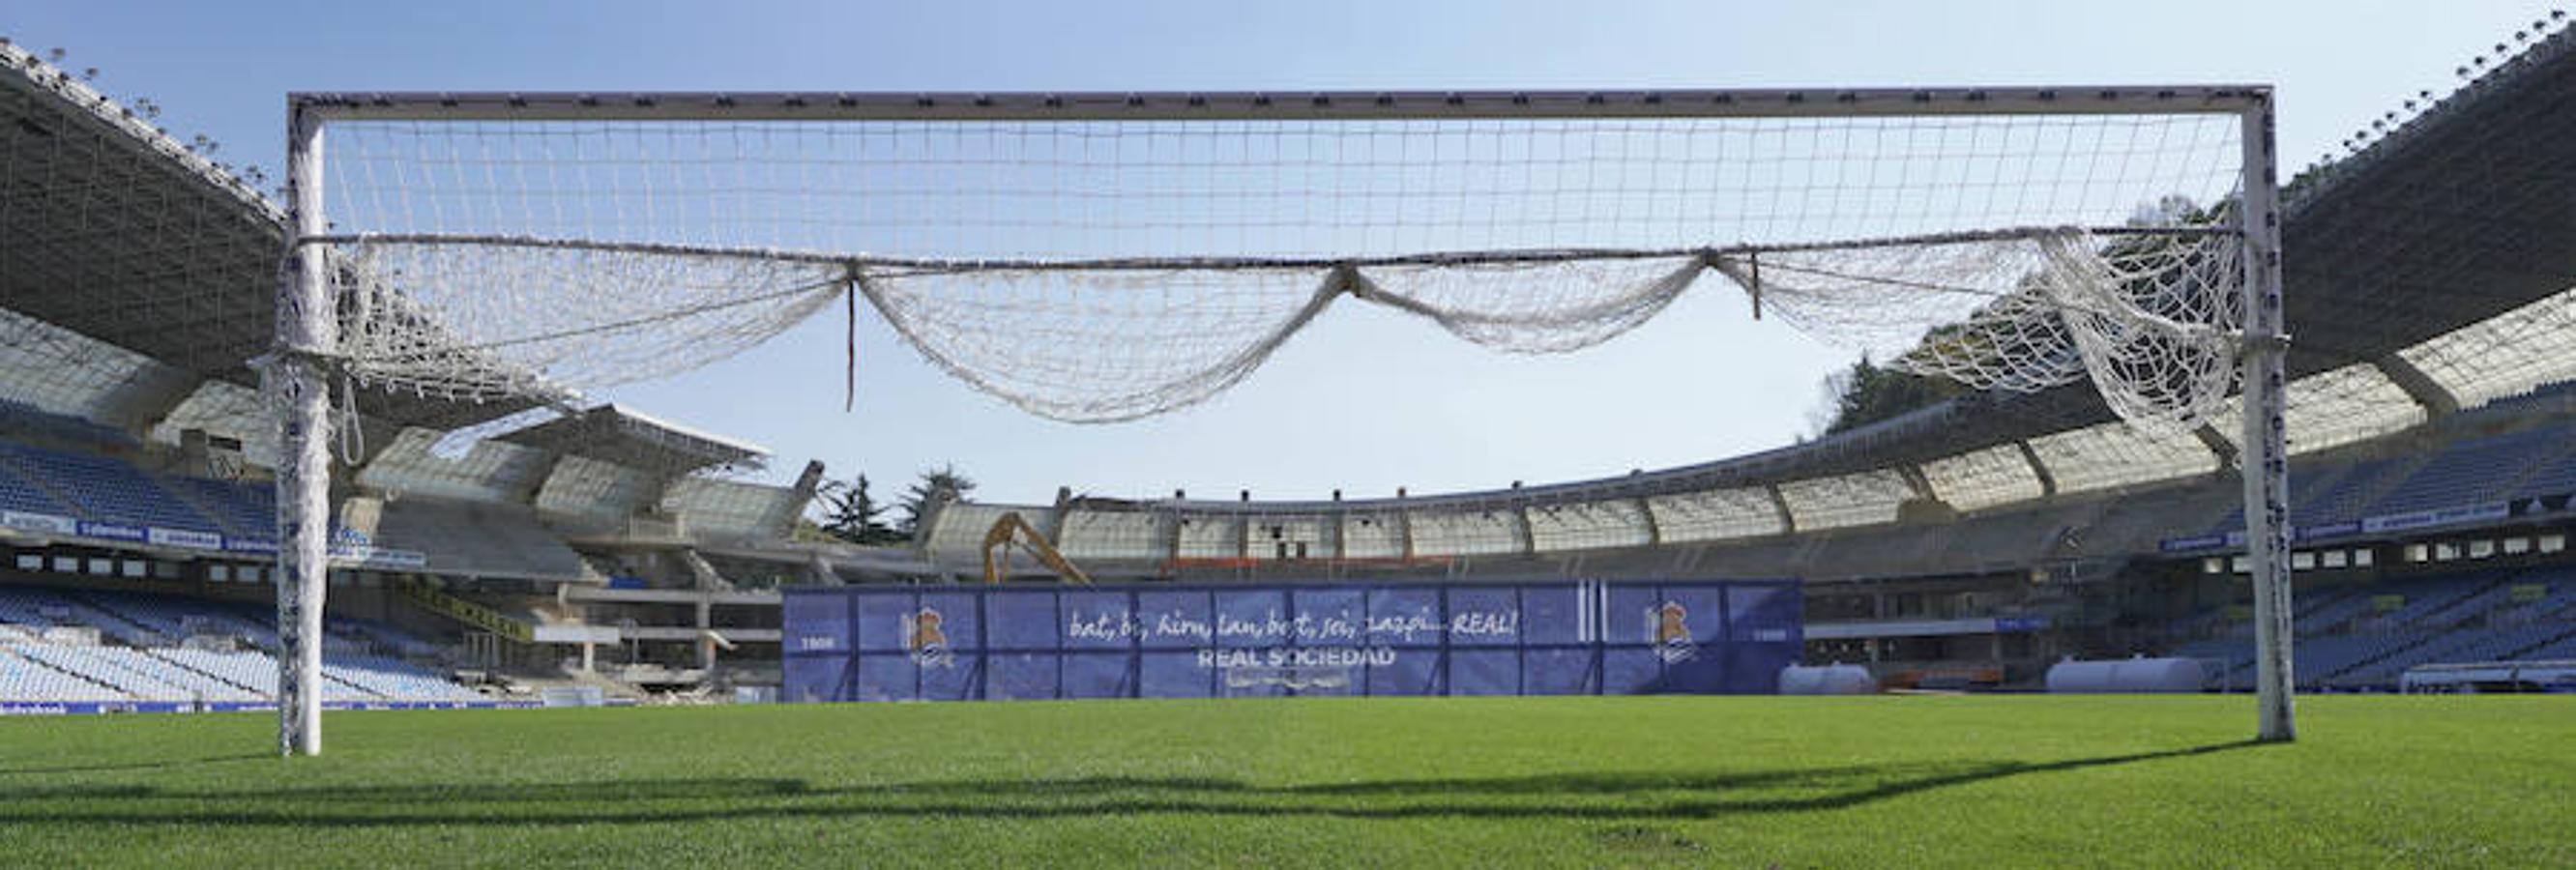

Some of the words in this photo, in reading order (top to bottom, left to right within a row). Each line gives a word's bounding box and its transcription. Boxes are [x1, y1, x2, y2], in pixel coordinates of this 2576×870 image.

[1451, 611, 1518, 636] REAL!
[1198, 648, 1262, 667] REAL
[1267, 647, 1396, 667] SOCIEDAD
